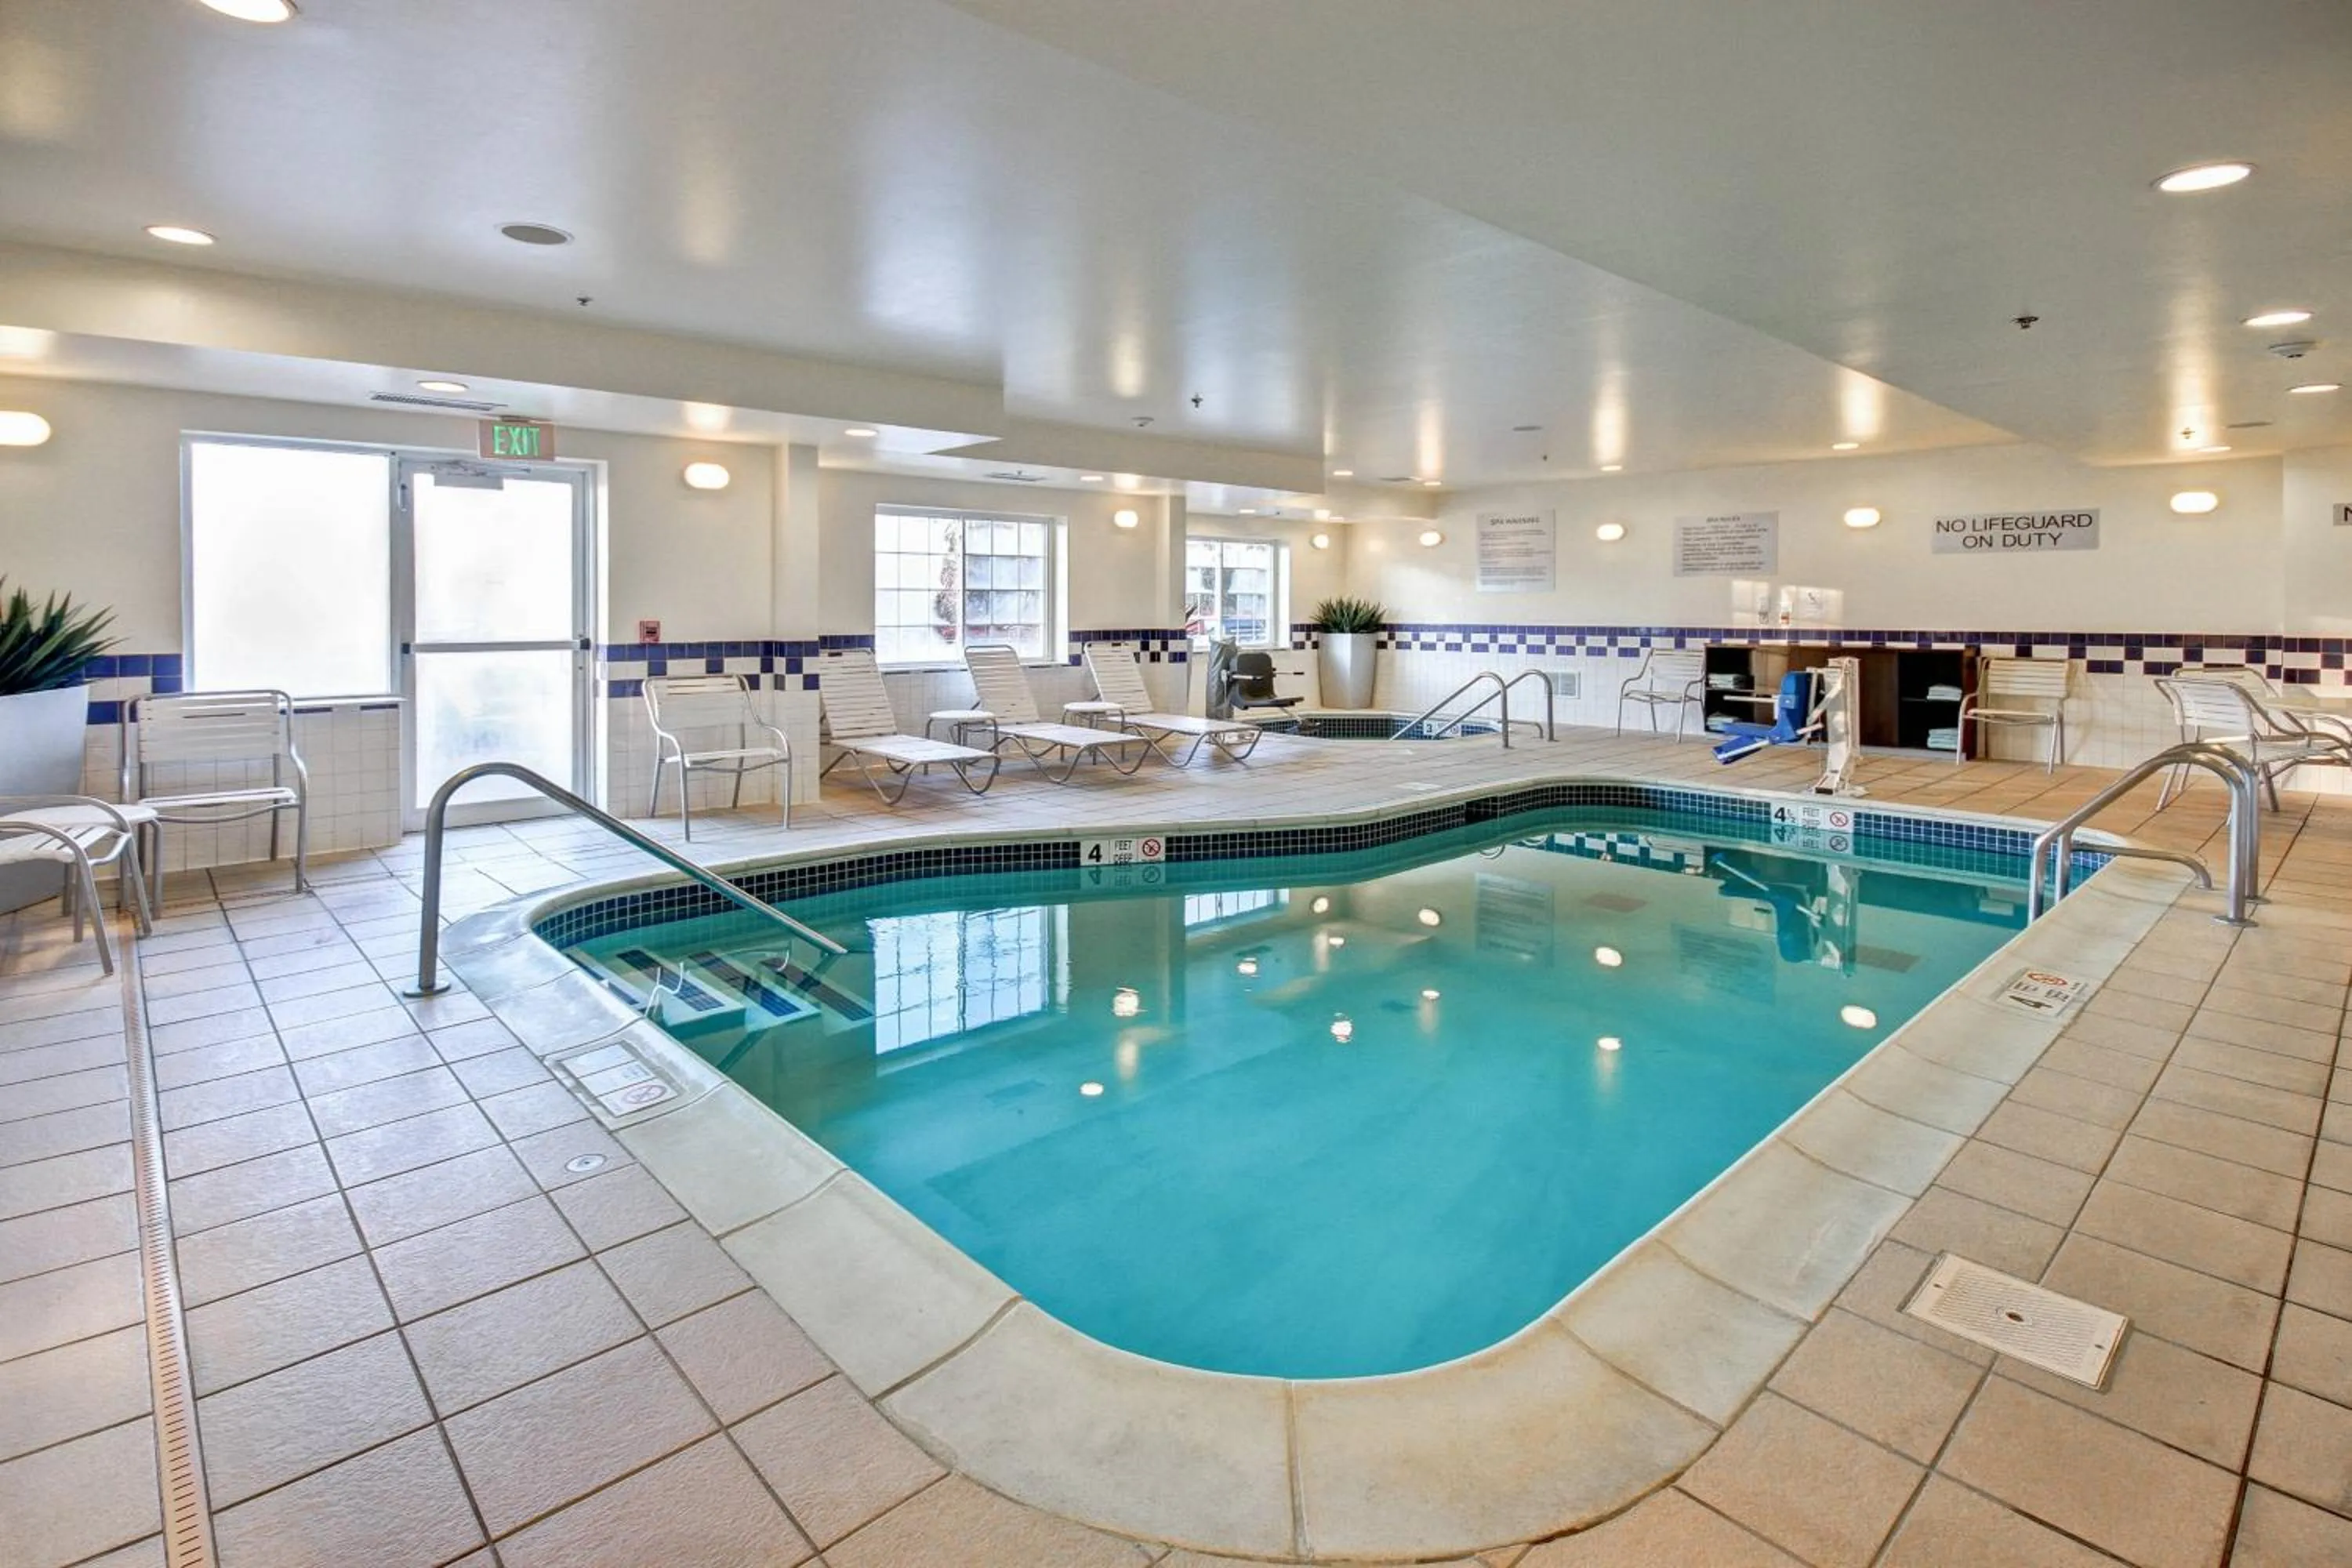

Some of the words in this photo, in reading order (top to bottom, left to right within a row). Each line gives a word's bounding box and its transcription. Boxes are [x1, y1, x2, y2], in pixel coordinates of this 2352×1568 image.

[493, 426, 540, 456] EXIT
[1936, 518, 1966, 533] NO
[1972, 514, 2092, 532] LIFEGUARD
[1962, 535, 1993, 549] ON
[2002, 532, 2063, 548] DUTY
[1426, 724, 1432, 733] 3
[1087, 843, 1102, 863] 4
[1114, 840, 1133, 851] FEET
